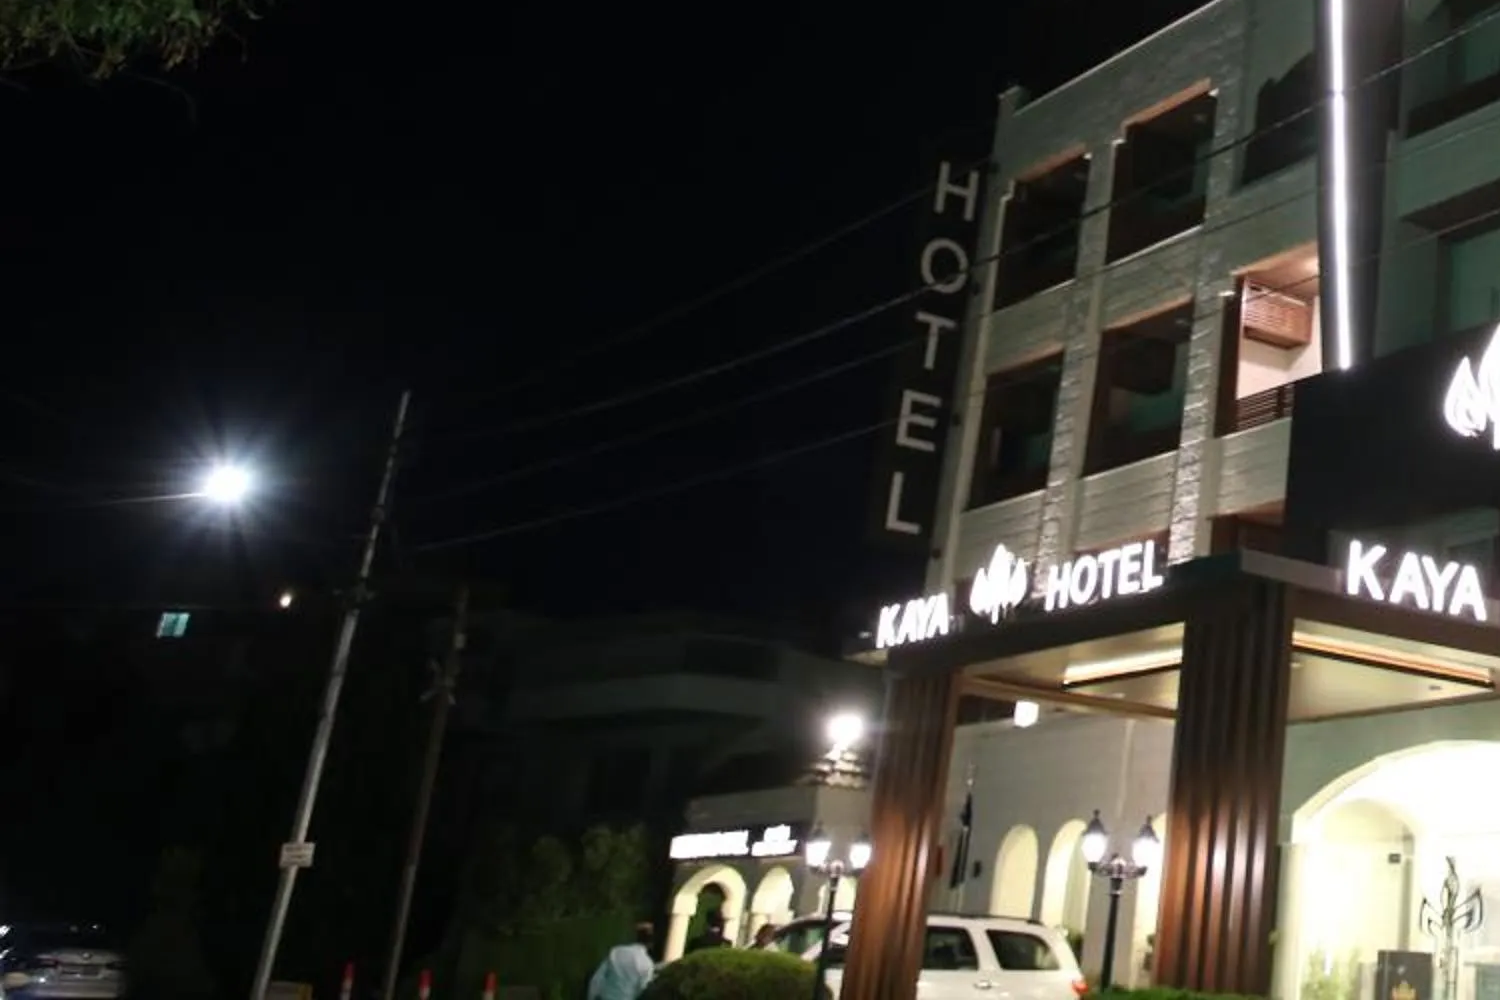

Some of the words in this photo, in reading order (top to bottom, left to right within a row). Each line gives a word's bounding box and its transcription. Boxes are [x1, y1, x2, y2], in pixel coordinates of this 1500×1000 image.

[885, 161, 980, 536] HOTEL
[876, 592, 952, 649] KAYA
[1044, 539, 1164, 612] HOTEL
[1347, 539, 1488, 622] KAYA
